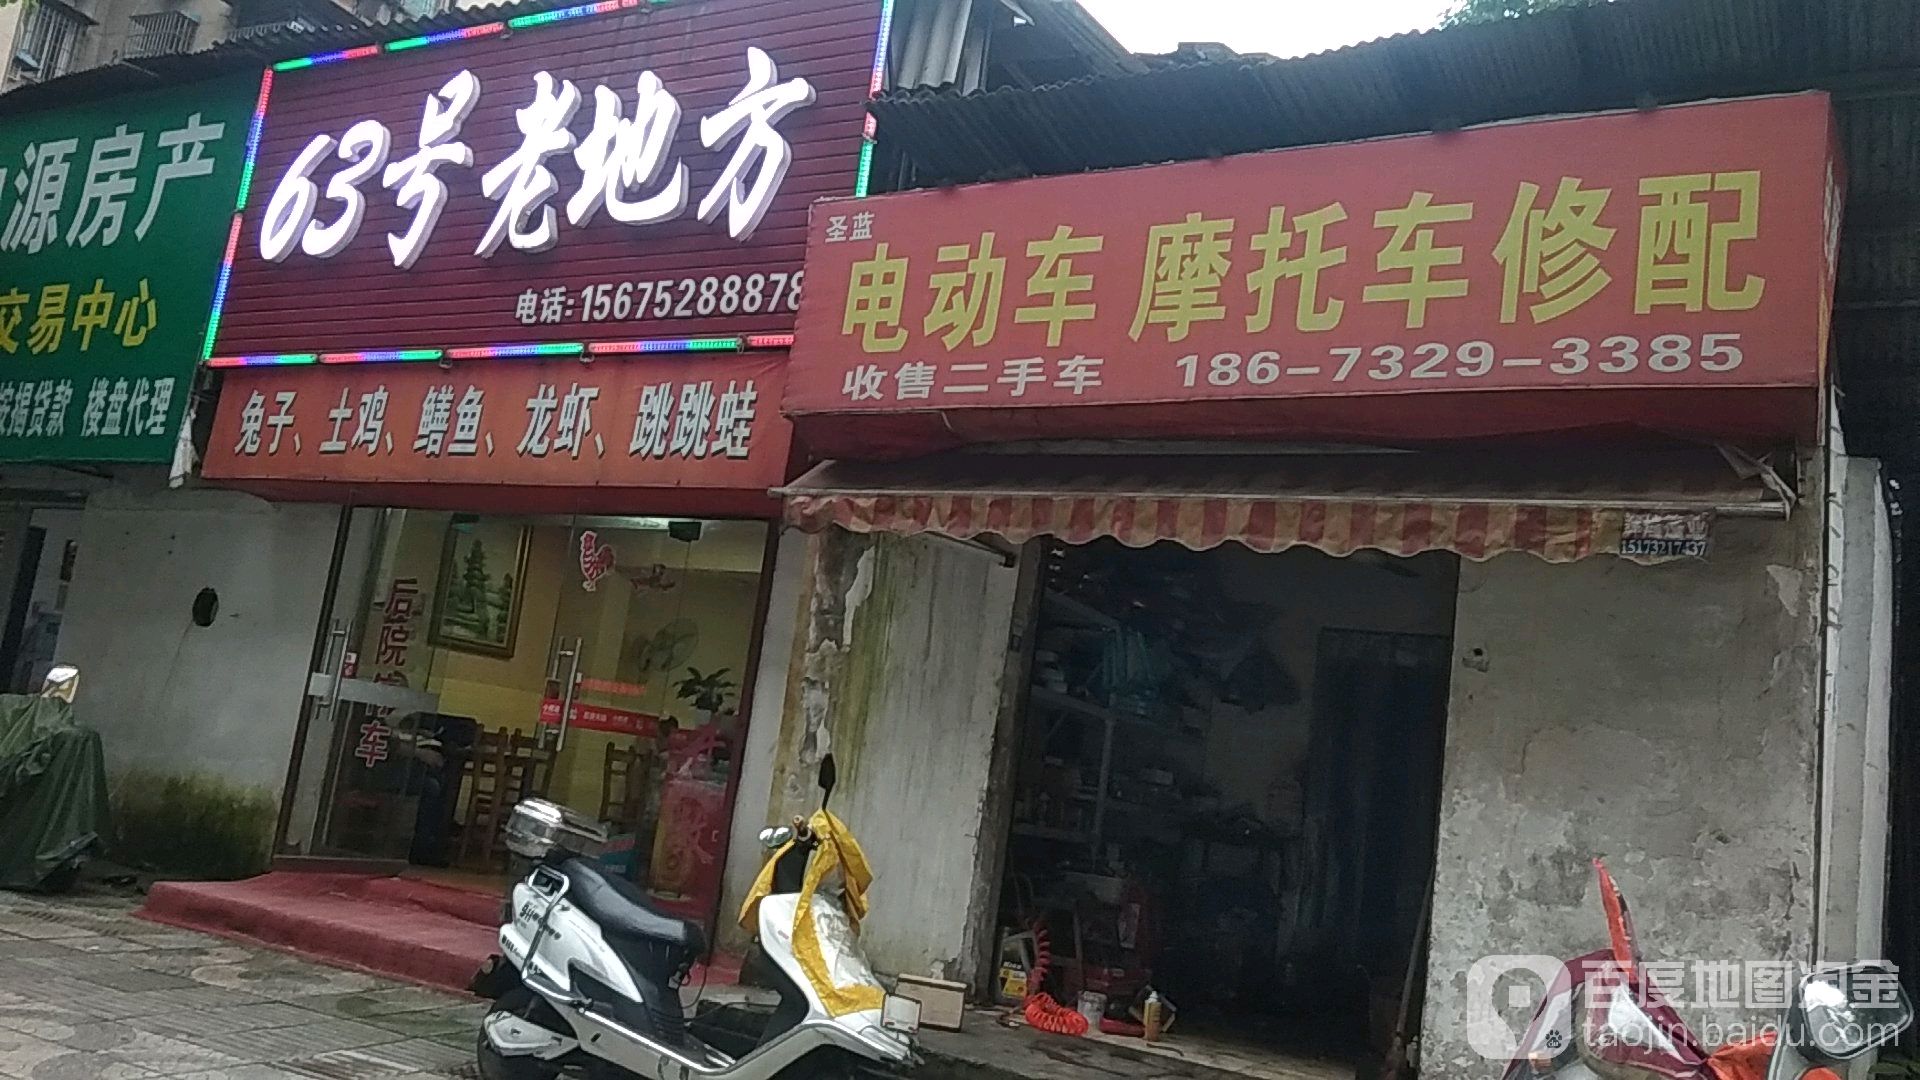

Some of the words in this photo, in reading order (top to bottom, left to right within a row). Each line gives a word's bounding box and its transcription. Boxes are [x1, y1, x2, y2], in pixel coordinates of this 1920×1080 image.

[0, 112, 225, 254] 源房产
[259, 46, 816, 270] 63号老地方
[825, 211, 875, 243] 圣蓝
[0, 278, 157, 355] 交易中心
[841, 355, 1104, 402] 收售二手车
[1175, 333, 1744, 388] 186-7329-3385
